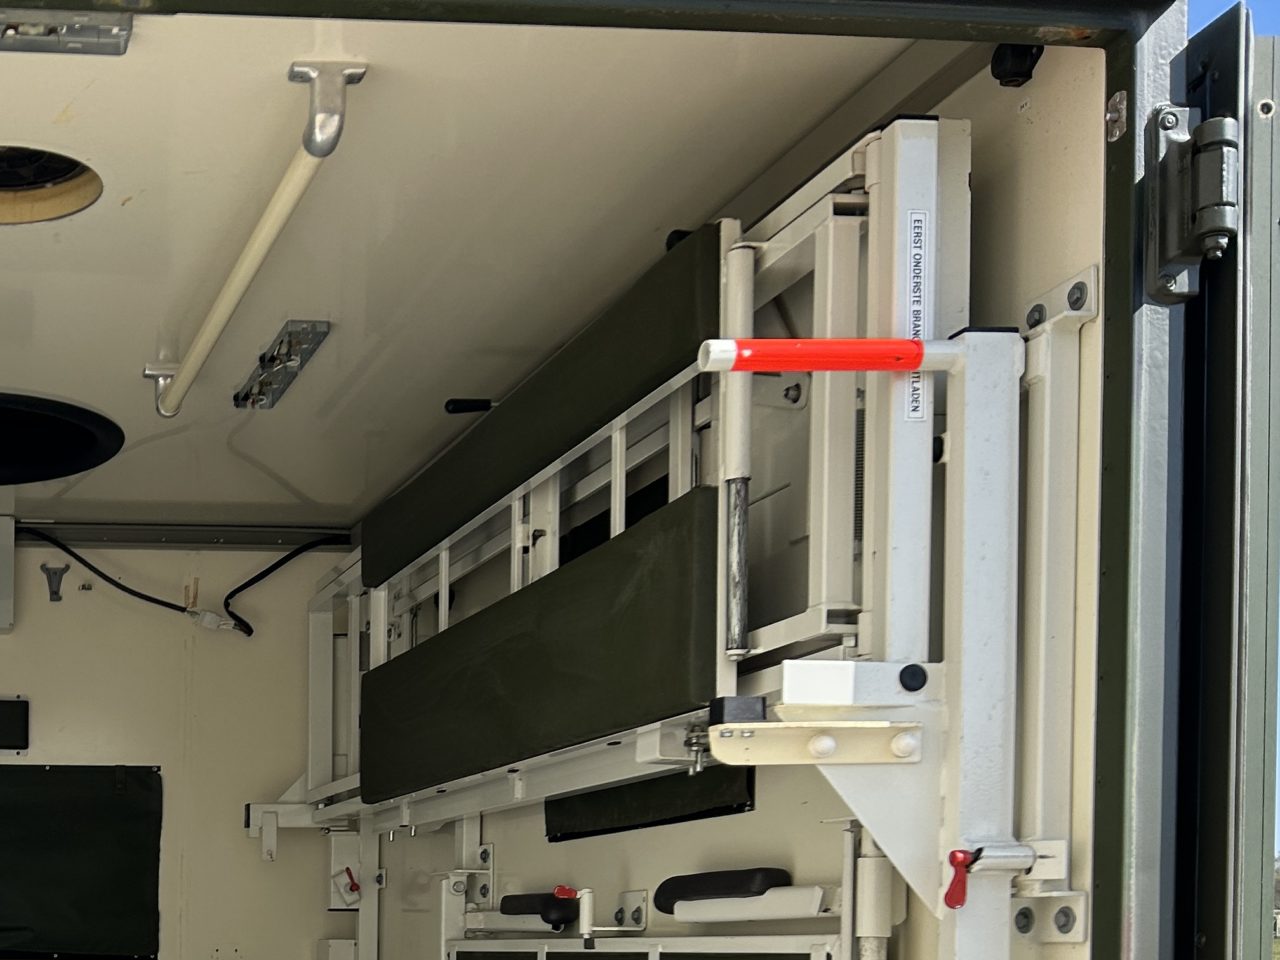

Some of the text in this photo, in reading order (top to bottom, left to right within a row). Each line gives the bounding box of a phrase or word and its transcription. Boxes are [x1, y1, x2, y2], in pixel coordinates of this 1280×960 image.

[913, 219, 923, 250] EERST
[912, 253, 923, 306] ONDERSTE
[911, 371, 920, 412] ITLADEN
